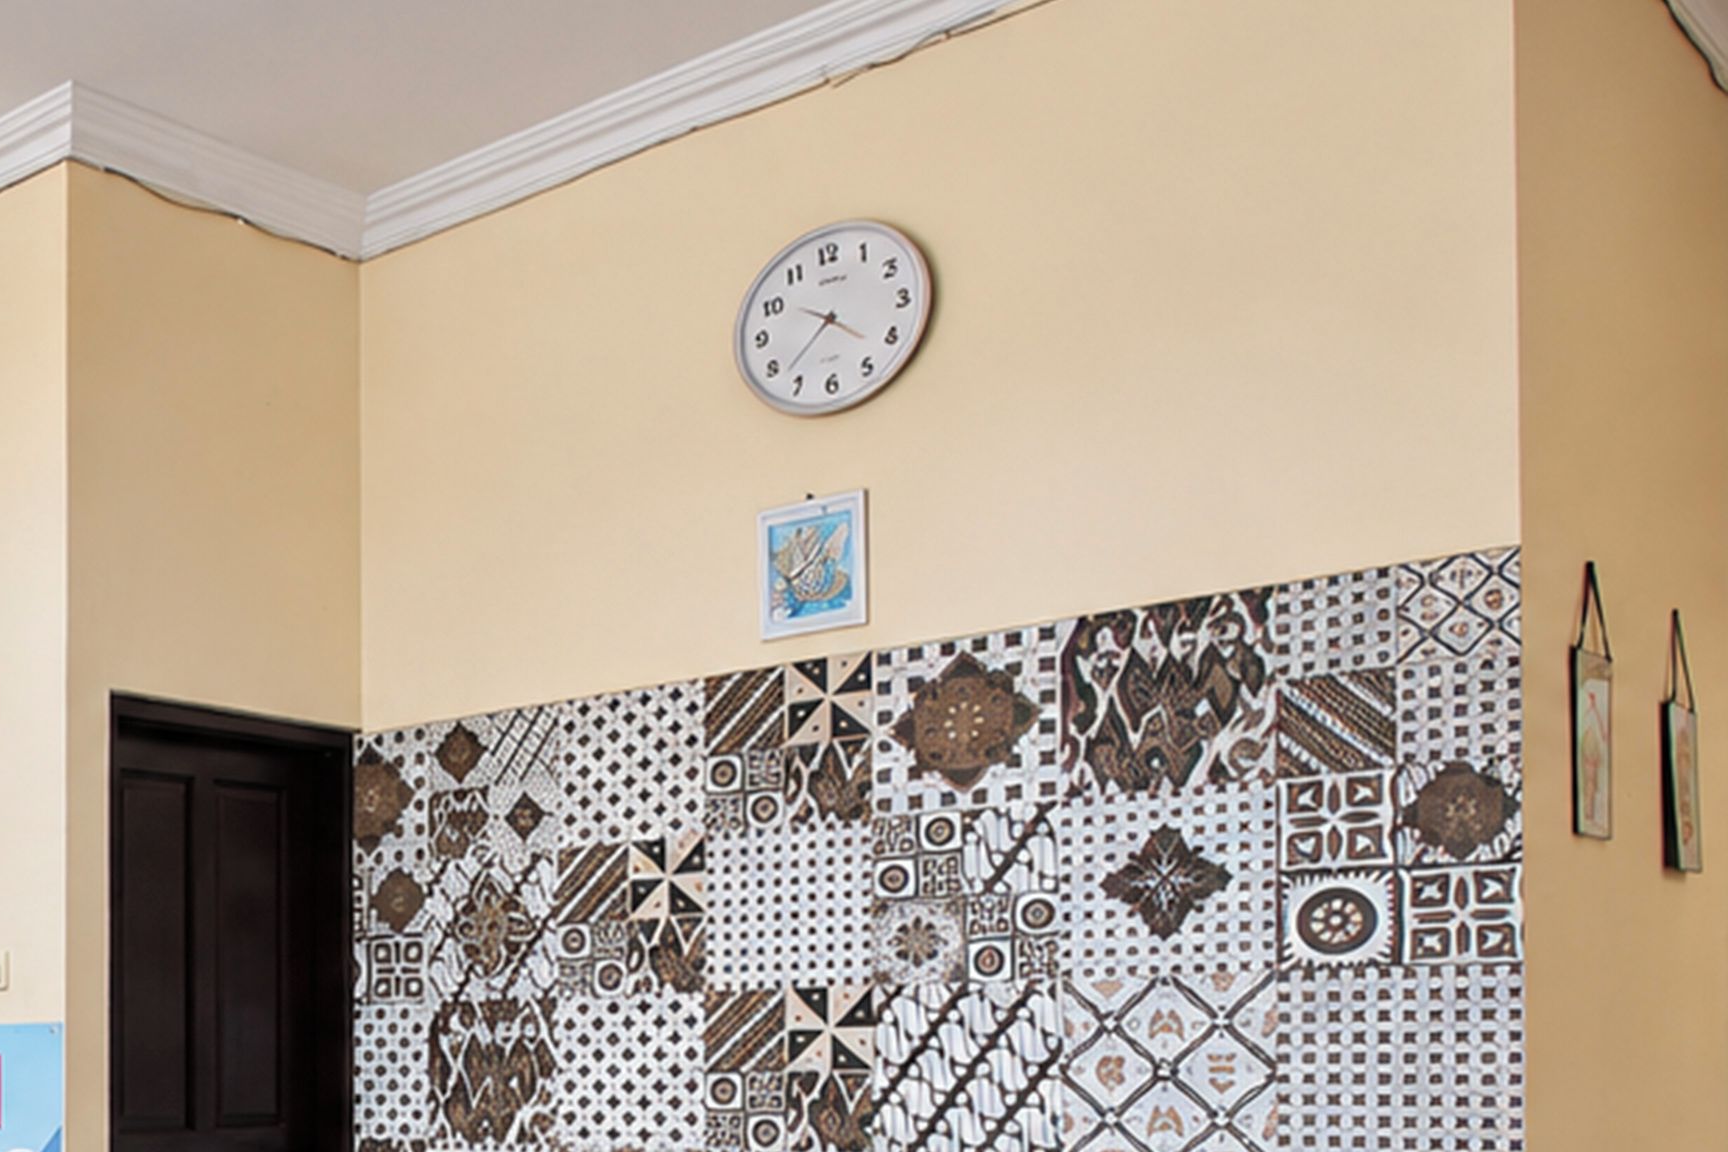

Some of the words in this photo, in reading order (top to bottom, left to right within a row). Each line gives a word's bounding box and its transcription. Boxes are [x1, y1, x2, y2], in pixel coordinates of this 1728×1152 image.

[818, 243, 839, 266] 12
[859, 243, 868, 263] 1
[787, 264, 803, 285] 11
[763, 297, 784, 317] 10
[896, 288, 911, 309] 3
[755, 330, 769, 349] 9
[861, 356, 874, 377] 5
[792, 375, 804, 396] 7
[825, 373, 839, 394] 6
